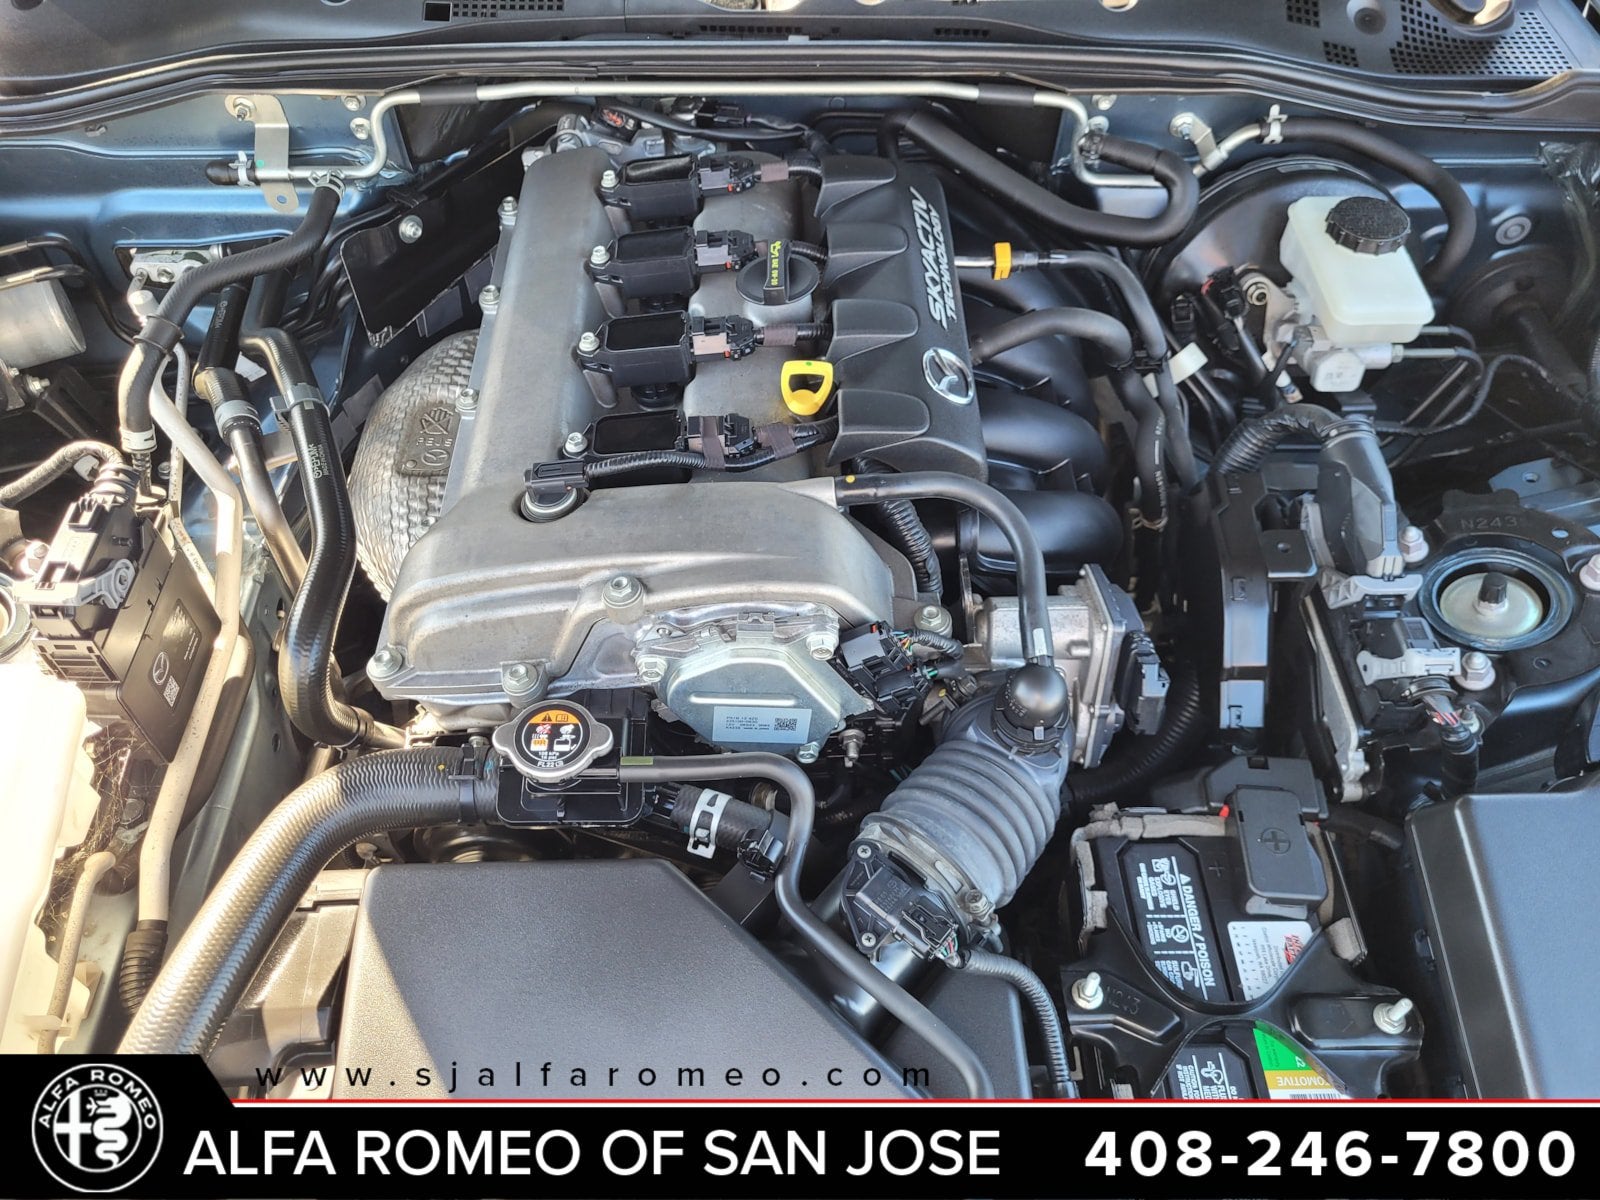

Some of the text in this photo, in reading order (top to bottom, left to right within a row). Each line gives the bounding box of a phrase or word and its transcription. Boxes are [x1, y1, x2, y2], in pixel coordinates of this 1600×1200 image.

[910, 186, 948, 331] SKYACTIV
[928, 204, 957, 323] TECHNOLOGY
[1460, 515, 1518, 530] N243
[1182, 886, 1202, 931] DANGER
[1196, 943, 1216, 987] POISON
